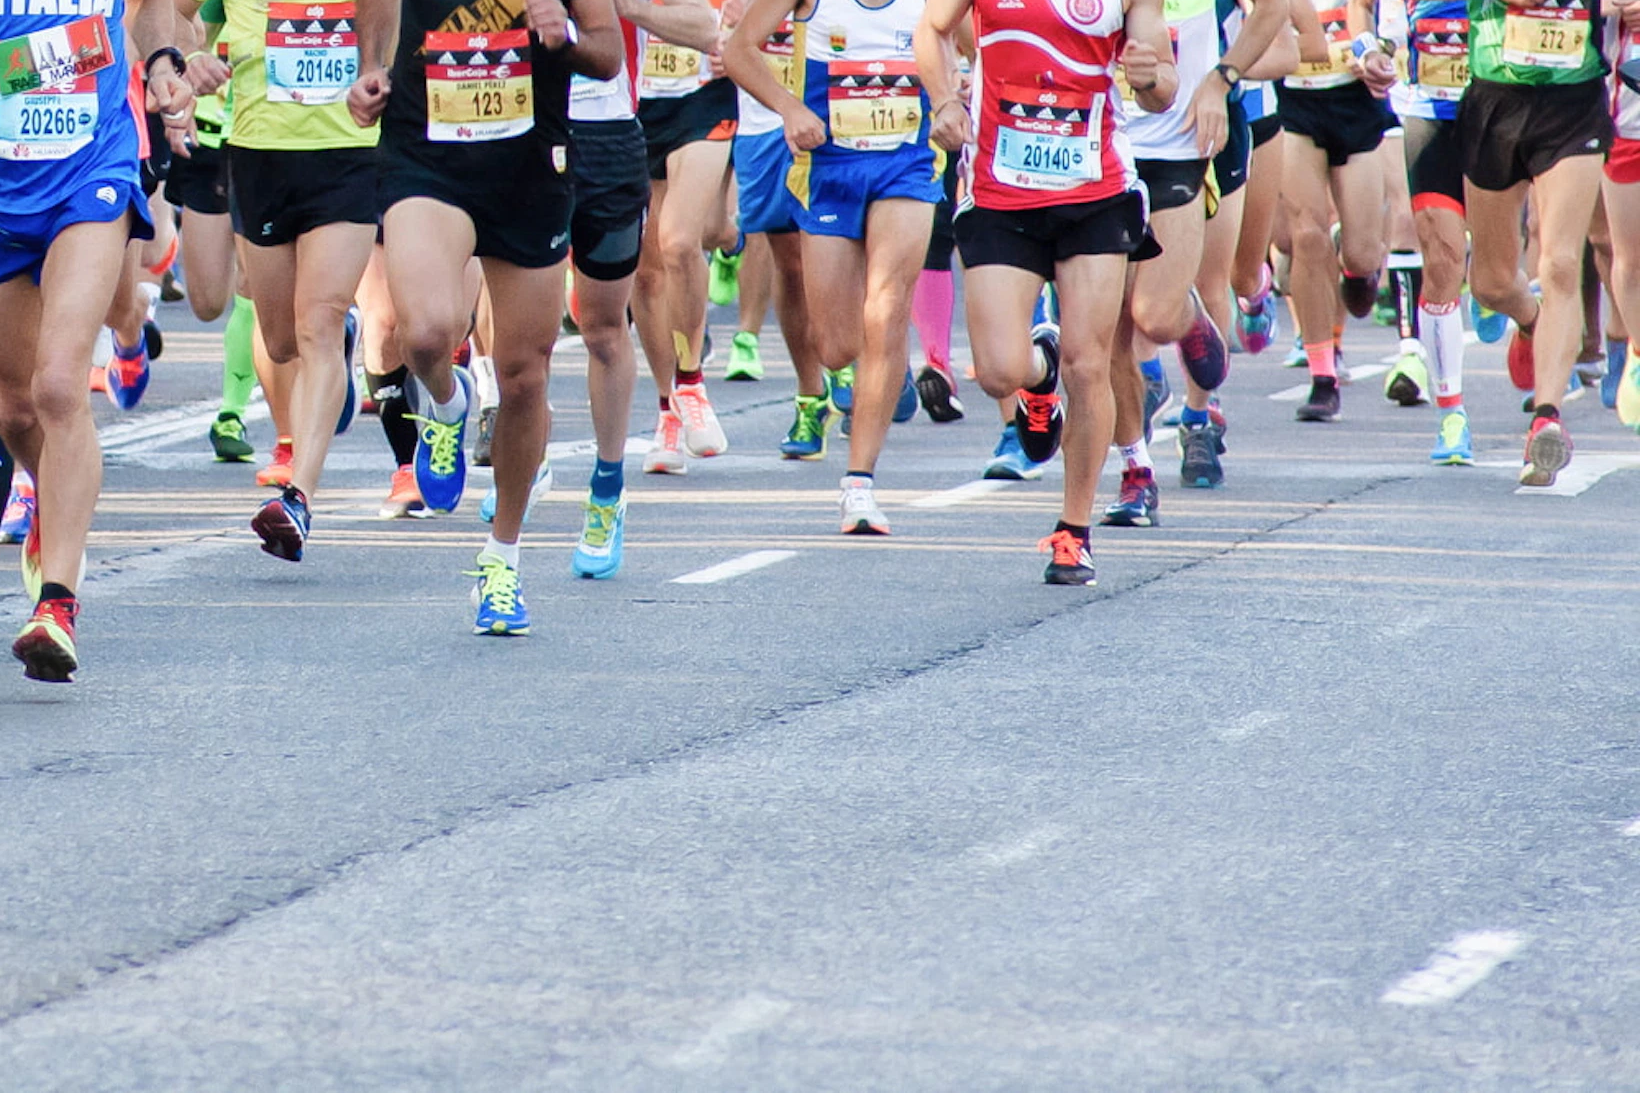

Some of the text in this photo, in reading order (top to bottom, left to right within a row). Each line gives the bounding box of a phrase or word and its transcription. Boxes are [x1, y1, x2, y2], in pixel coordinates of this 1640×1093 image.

[1540, 28, 1565, 49] 272
[296, 58, 343, 83] 20146
[653, 52, 677, 74] 148
[472, 91, 504, 116] 123
[20, 108, 76, 135] 20266
[871, 109, 895, 131] 171
[1023, 143, 1070, 171] 20140
